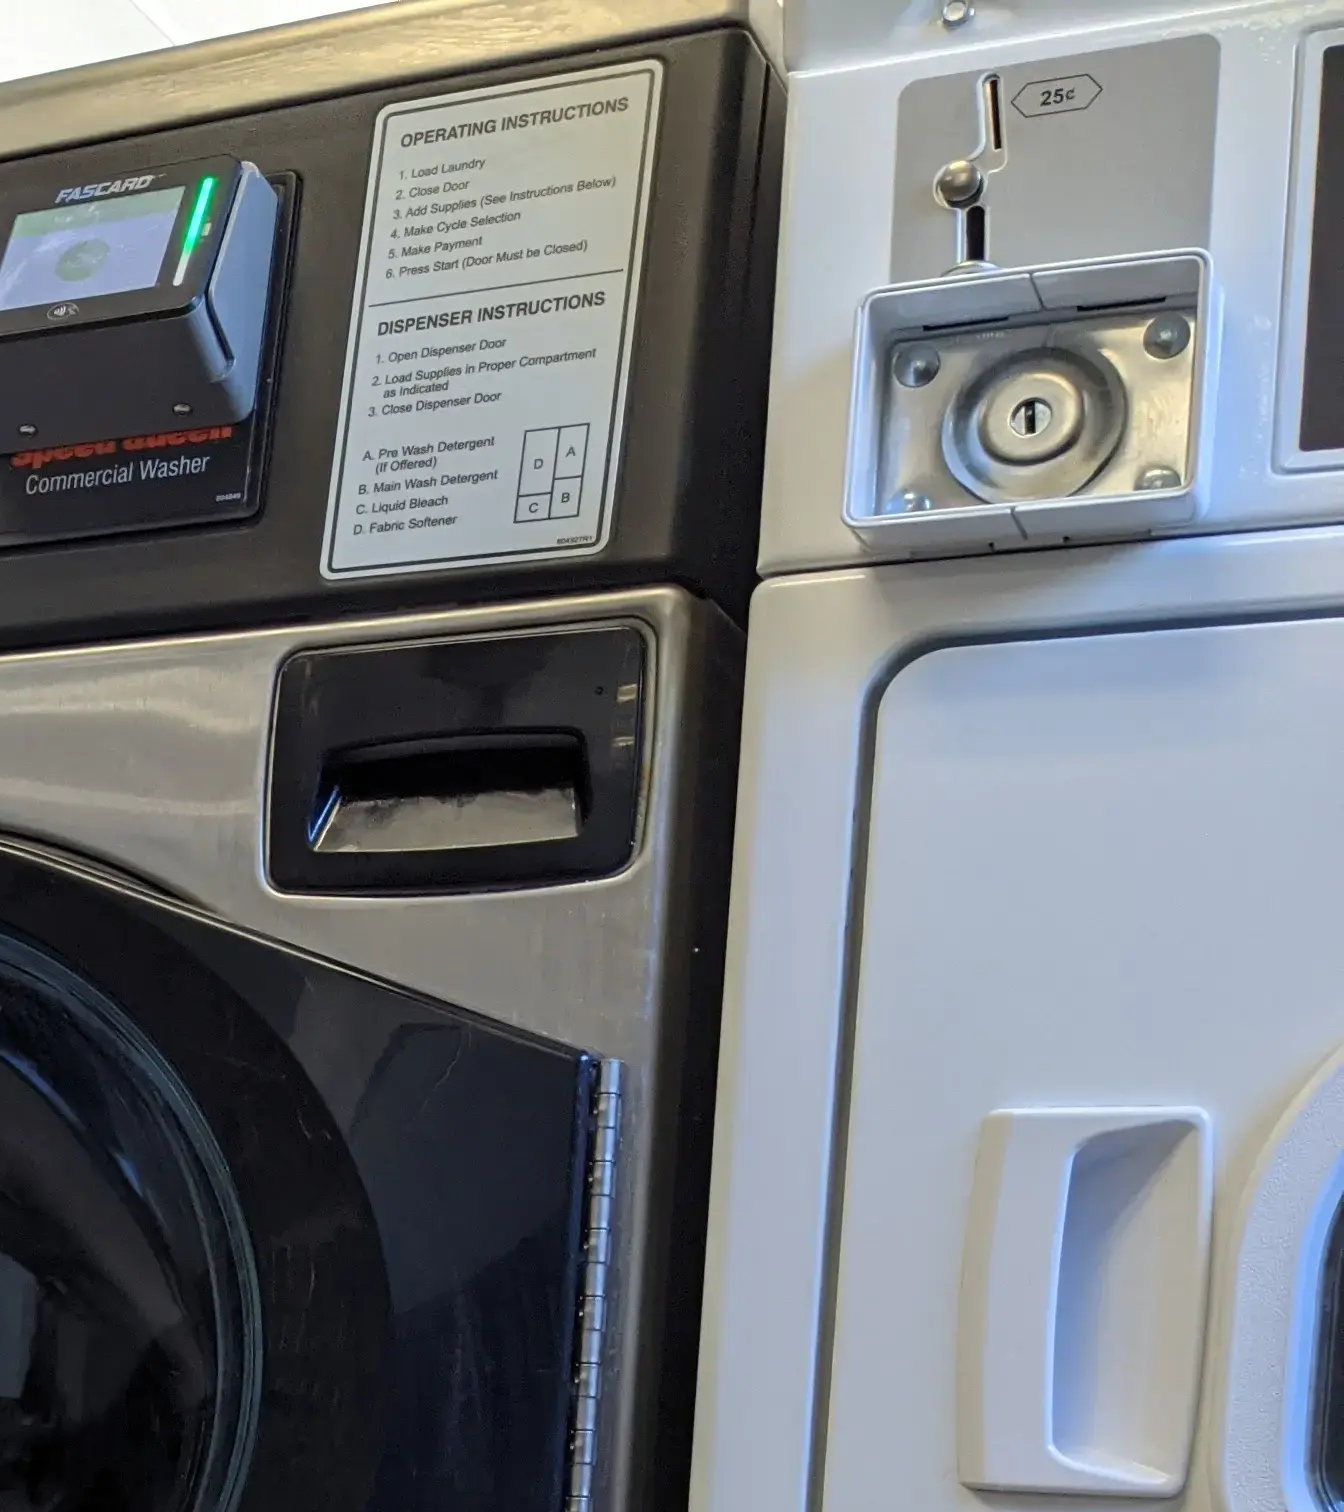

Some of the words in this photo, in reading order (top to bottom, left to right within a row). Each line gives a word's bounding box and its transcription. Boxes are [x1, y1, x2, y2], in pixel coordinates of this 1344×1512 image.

[1040, 87, 1075, 107] 25¢
[400, 119, 497, 148] OPERATING
[501, 96, 629, 131] INSTRUCTIONS
[399, 170, 408, 180] 1.
[411, 165, 439, 179] Load
[441, 158, 486, 174] Laundry
[55, 174, 155, 204] FASCARD
[392, 208, 402, 220] 3.
[405, 204, 428, 218] Add
[430, 199, 477, 214] Supplies
[480, 194, 507, 209] (See
[509, 184, 574, 202] Instructions
[576, 176, 616, 192] Below)
[395, 189, 405, 201] 2.
[408, 185, 440, 198] Close
[442, 180, 470, 193] Door
[390, 228, 401, 239] 4.
[403, 224, 434, 238] Make
[436, 219, 467, 234] Cycle
[470, 212, 521, 228] Selection
[385, 268, 395, 279] 6.
[399, 264, 430, 277] Press
[432, 259, 459, 272] Start
[461, 255, 494, 270] (Door
[495, 249, 524, 263] Must
[526, 248, 541, 258] be
[543, 239, 588, 256] Closed)
[387, 248, 398, 260] 5.
[401, 244, 431, 257] Make
[433, 236, 483, 253] Payment
[377, 309, 473, 336] DISPENSER
[477, 291, 605, 323] INSTRUCTIONS
[375, 353, 384, 364] 1.
[388, 351, 418, 364] Open
[420, 343, 477, 359] Dispenser
[479, 339, 507, 351] Door
[371, 375, 382, 387] 2.
[384, 372, 413, 385] Load
[415, 366, 462, 381] Supplies
[465, 363, 475, 375] in
[478, 360, 517, 373] Proper
[519, 348, 597, 367] Compartment
[383, 389, 397, 399] as
[399, 379, 449, 396] Indicated
[367, 406, 377, 418] 3.
[381, 404, 413, 416] Close
[415, 396, 471, 412] Dispenser
[473, 392, 502, 404] Door
[362, 450, 374, 461] A.
[378, 448, 399, 459] Pre
[401, 443, 434, 457] Wash
[437, 436, 495, 453] Detergent
[565, 446, 576, 458] A
[25, 464, 133, 495] Commercial
[139, 455, 210, 481] Washer
[375, 461, 388, 475] (If
[389, 456, 437, 472] Offered)
[533, 458, 544, 470] D
[358, 484, 369, 495] B.
[373, 482, 401, 493] Main
[404, 476, 437, 490] Wash
[440, 469, 498, 486] Detergent
[355, 503, 368, 515] C.
[371, 499, 406, 515] Liquid
[409, 495, 449, 509] Bleach
[528, 502, 539, 514] C
[561, 492, 570, 503] B
[353, 524, 363, 536] D.
[369, 521, 405, 534] Fabric
[408, 516, 458, 529] Softener
